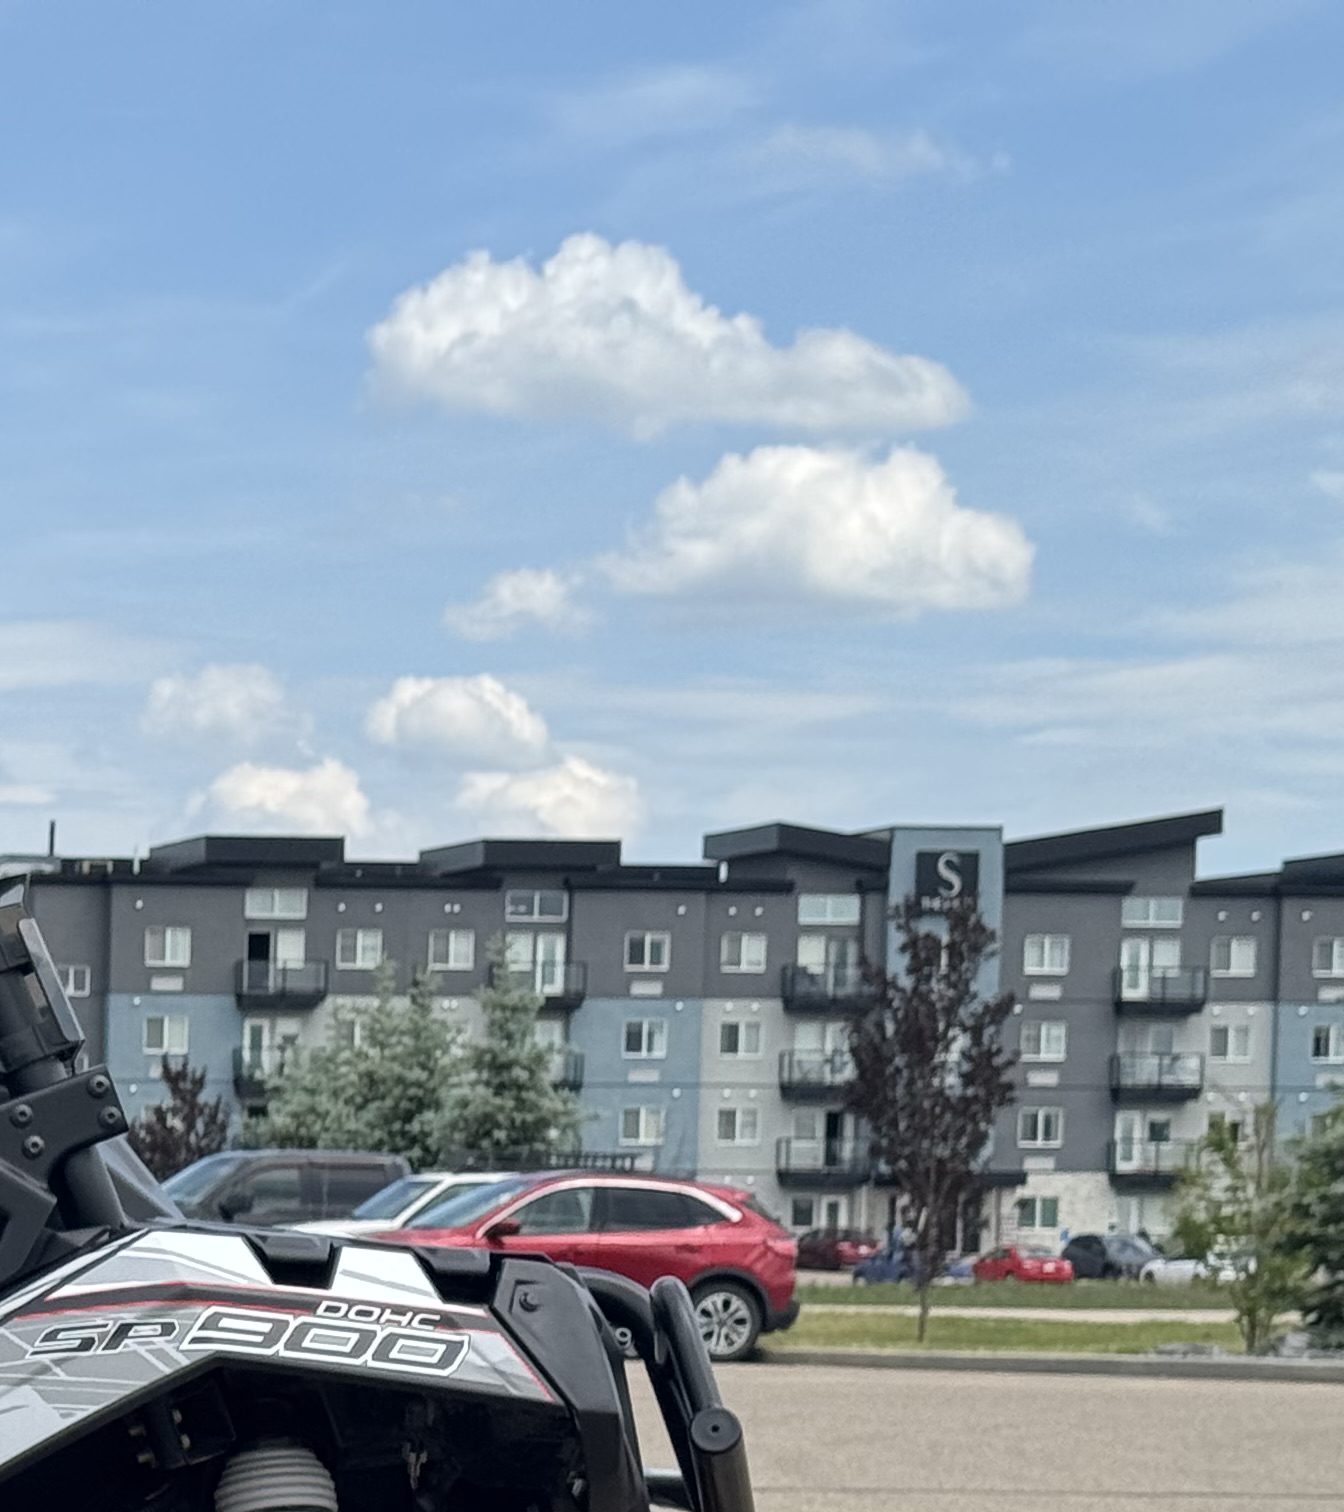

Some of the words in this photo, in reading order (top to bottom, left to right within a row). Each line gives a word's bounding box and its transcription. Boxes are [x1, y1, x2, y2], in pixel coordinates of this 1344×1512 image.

[315, 1300, 442, 1329] DOHC
[26, 1318, 180, 1359] SP
[178, 1306, 470, 1376] 900
